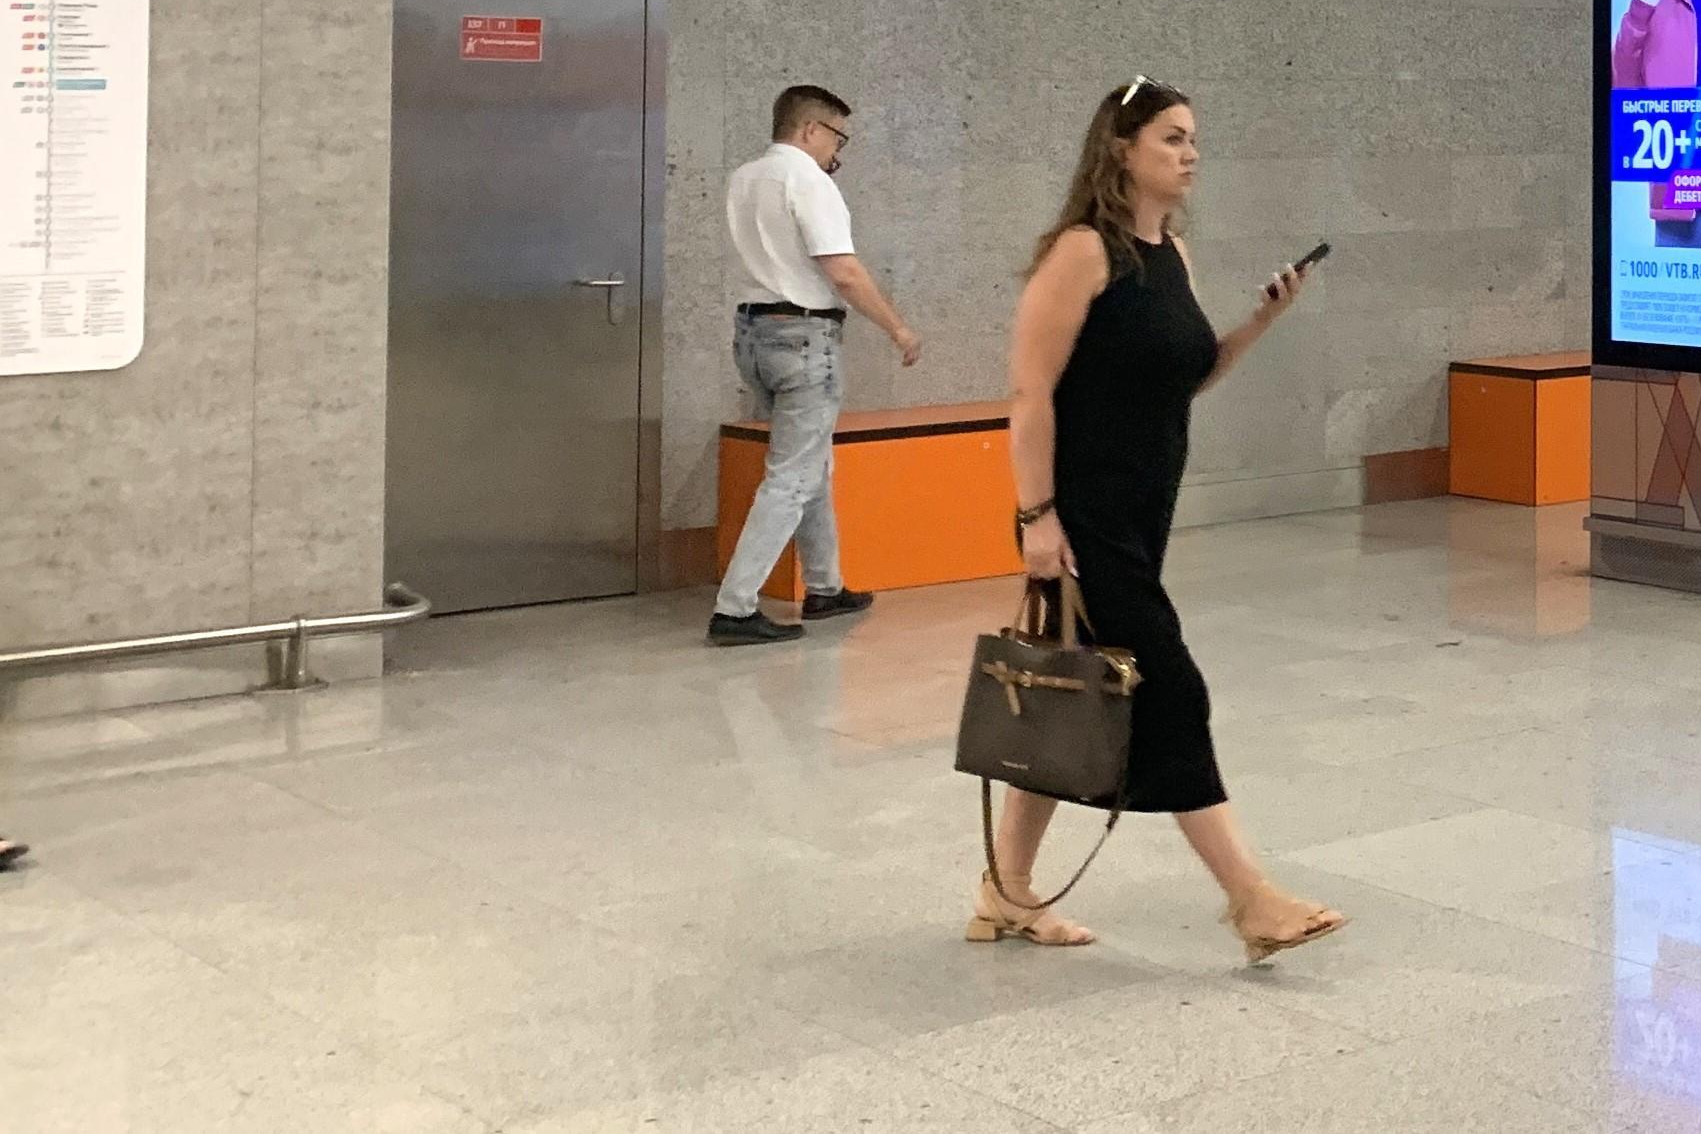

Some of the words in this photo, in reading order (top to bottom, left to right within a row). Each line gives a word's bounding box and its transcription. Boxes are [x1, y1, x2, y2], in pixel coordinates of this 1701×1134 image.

[1622, 100, 1669, 114] БЫСТРЫЕ
[1632, 119, 1692, 170] 20+
[1630, 260, 1658, 278] 1000
